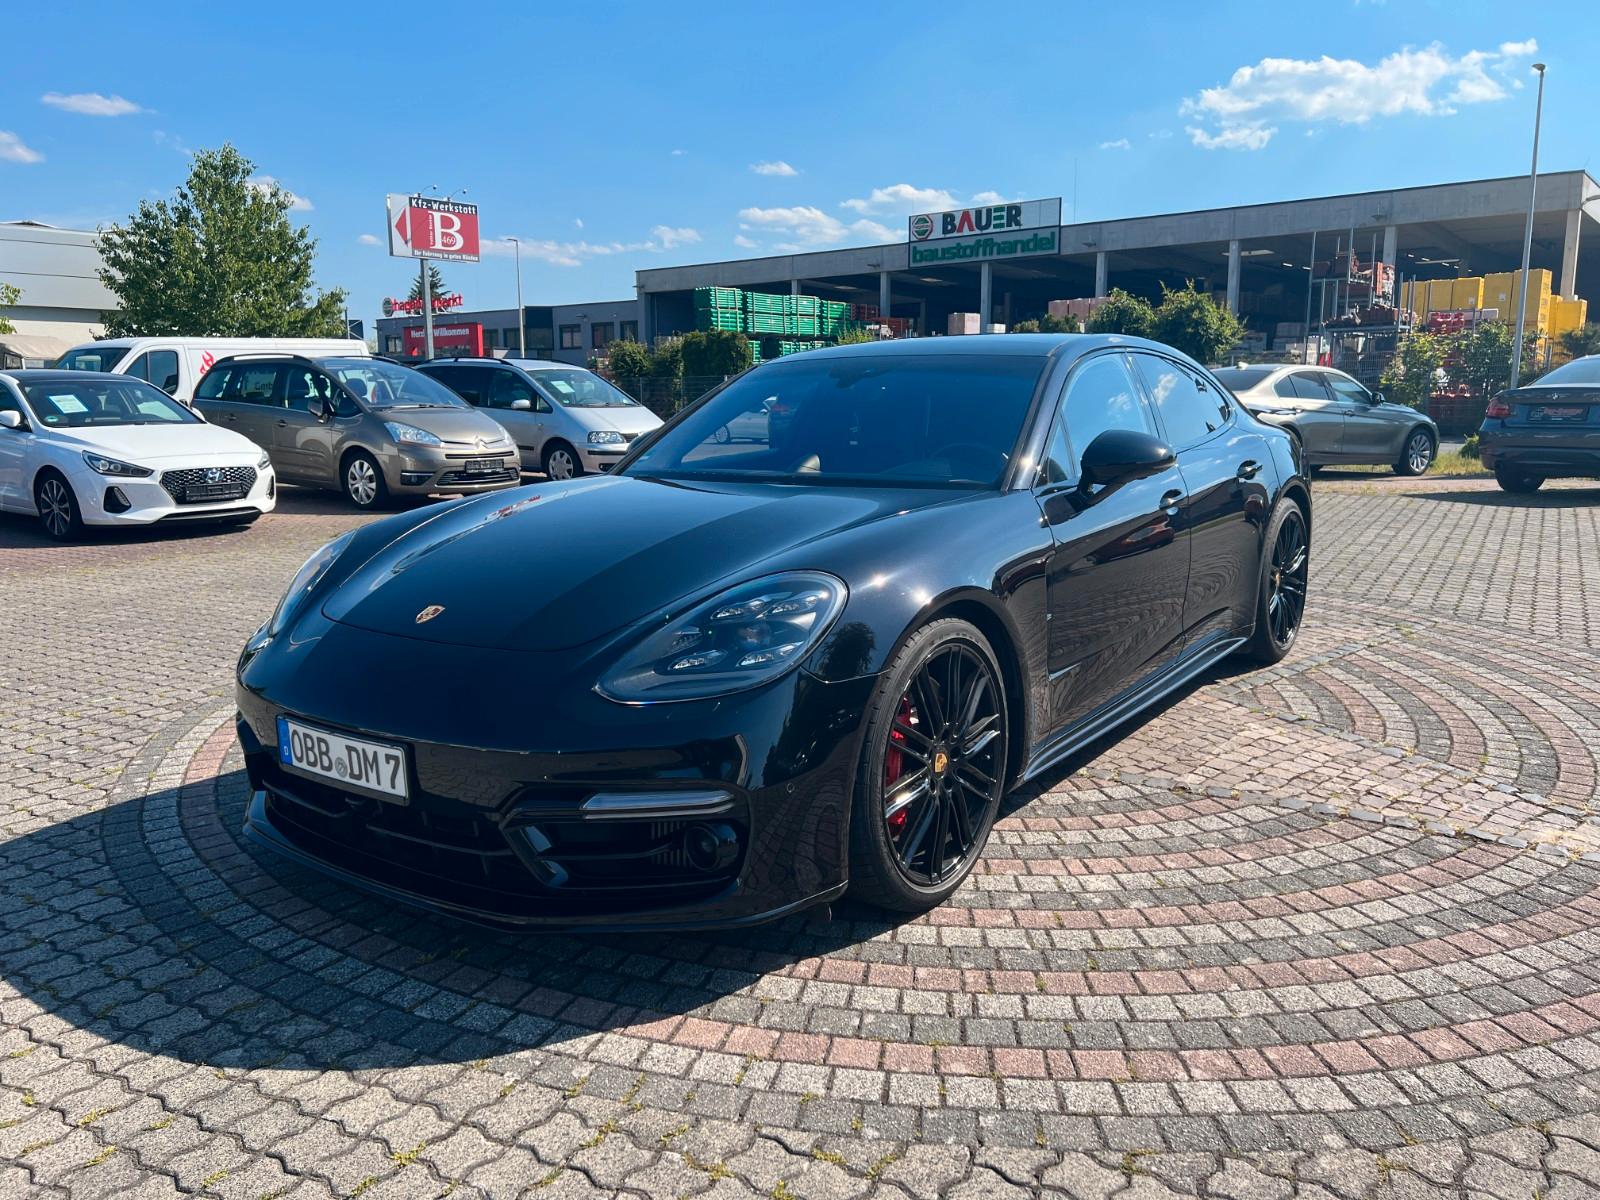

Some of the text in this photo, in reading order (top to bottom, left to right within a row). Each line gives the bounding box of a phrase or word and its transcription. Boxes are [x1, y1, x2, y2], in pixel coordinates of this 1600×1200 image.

[411, 198, 476, 215] Kfz-Werkstatt
[942, 205, 1022, 235] BAUER
[428, 210, 464, 251] B
[441, 234, 456, 246] 469
[912, 231, 1056, 264] baustoffhandel
[434, 327, 469, 337] Willkommen
[291, 729, 400, 790] OBB DM 7
